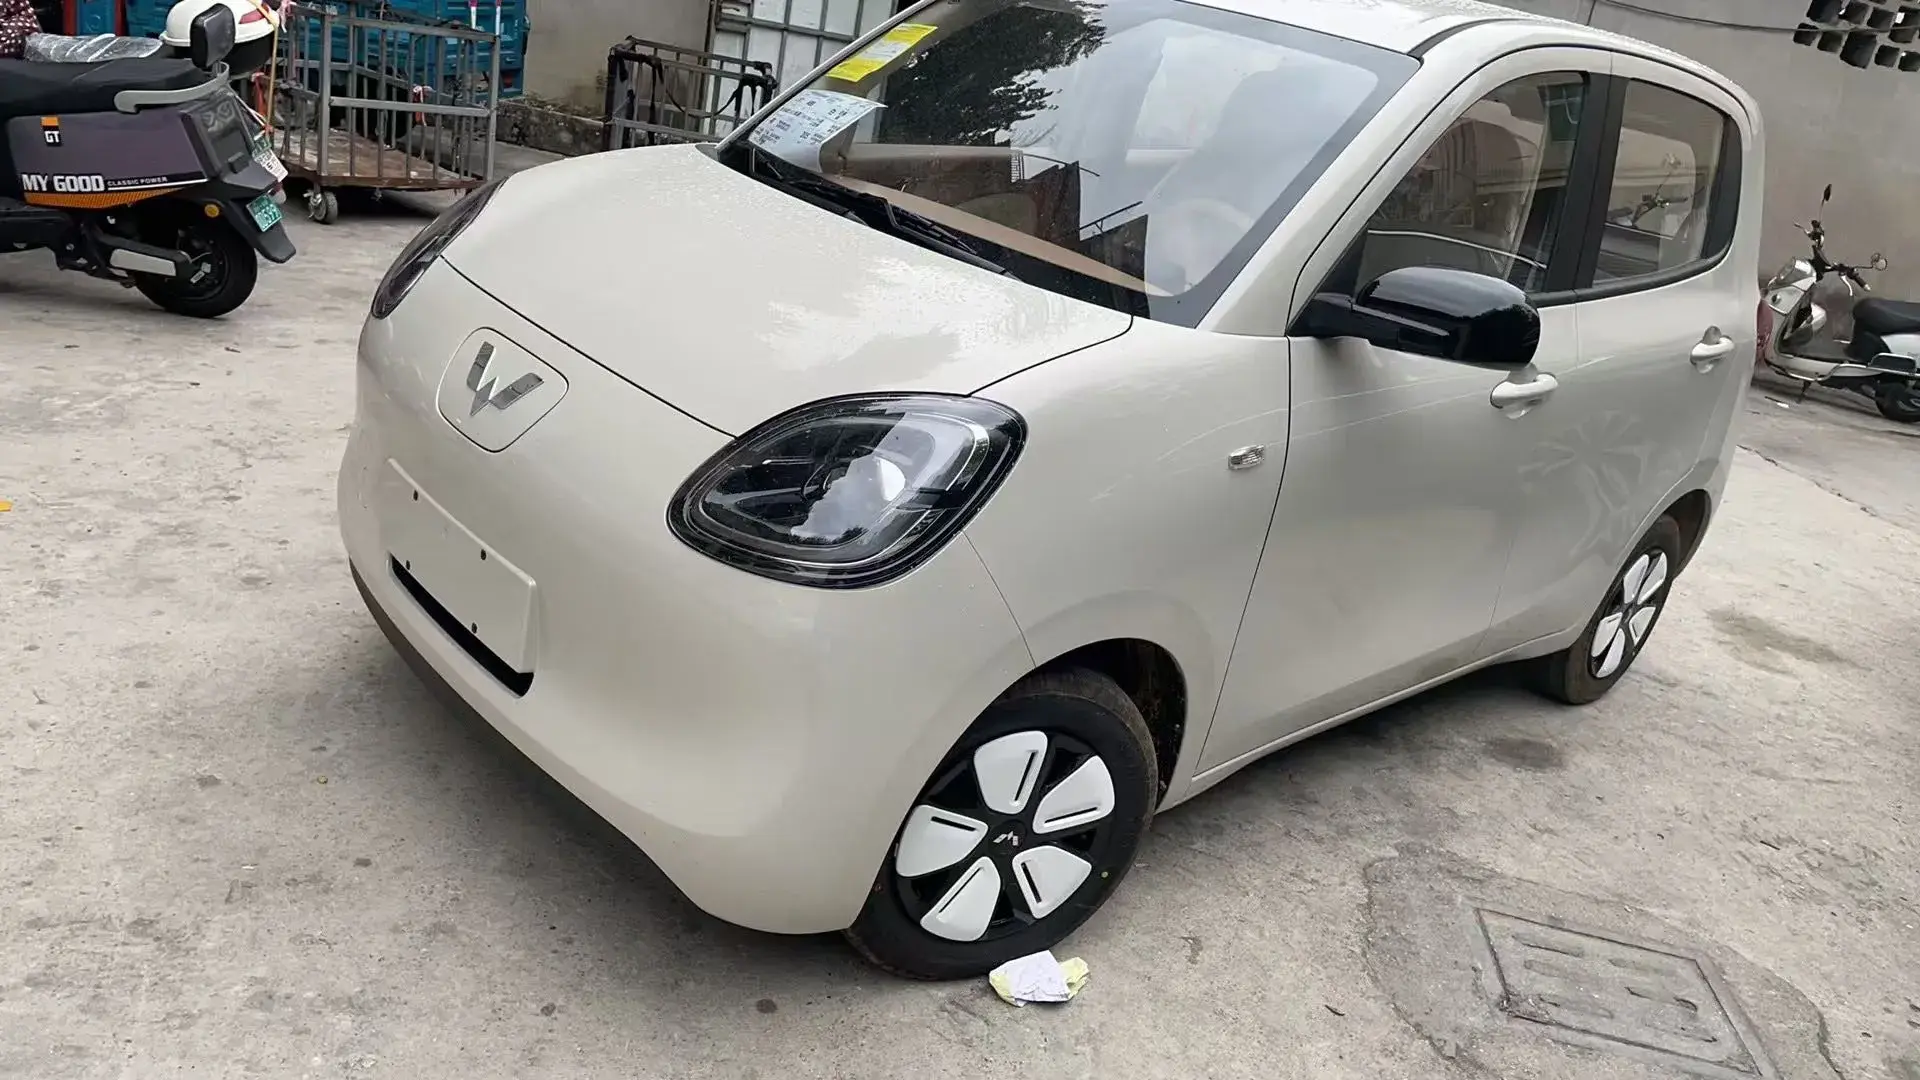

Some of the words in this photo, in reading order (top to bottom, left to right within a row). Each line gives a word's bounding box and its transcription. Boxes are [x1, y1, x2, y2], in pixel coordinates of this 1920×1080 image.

[44, 130, 60, 143] GT
[22, 174, 48, 192] MY
[53, 174, 104, 193] GOOD
[107, 178, 139, 187] CLASSIC
[139, 176, 168, 185] POWER
